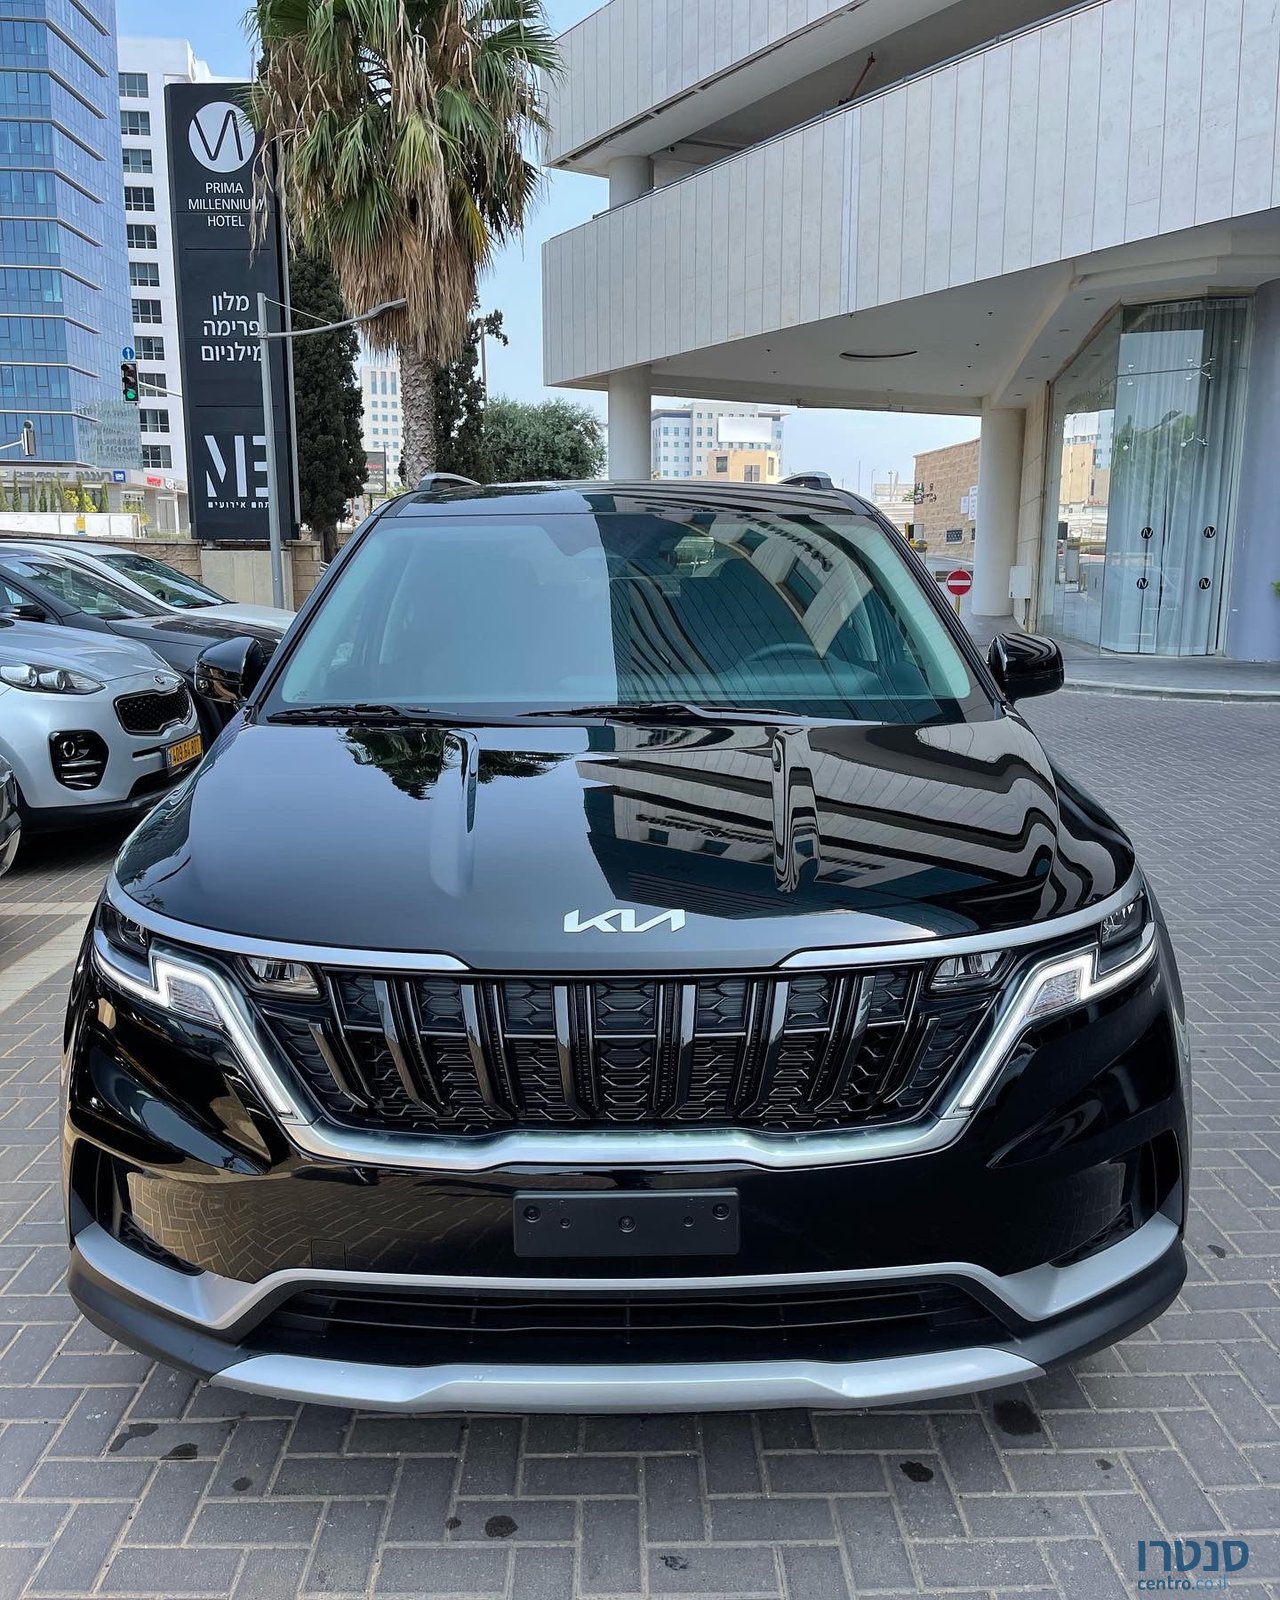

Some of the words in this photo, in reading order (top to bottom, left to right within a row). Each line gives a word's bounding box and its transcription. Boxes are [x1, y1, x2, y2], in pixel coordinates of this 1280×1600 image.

[205, 182, 244, 194] PRIMA
[207, 215, 245, 227] HOTEL
[212, 291, 250, 316] מלון
[203, 320, 260, 337] פרימה
[563, 908, 686, 933] KIA
